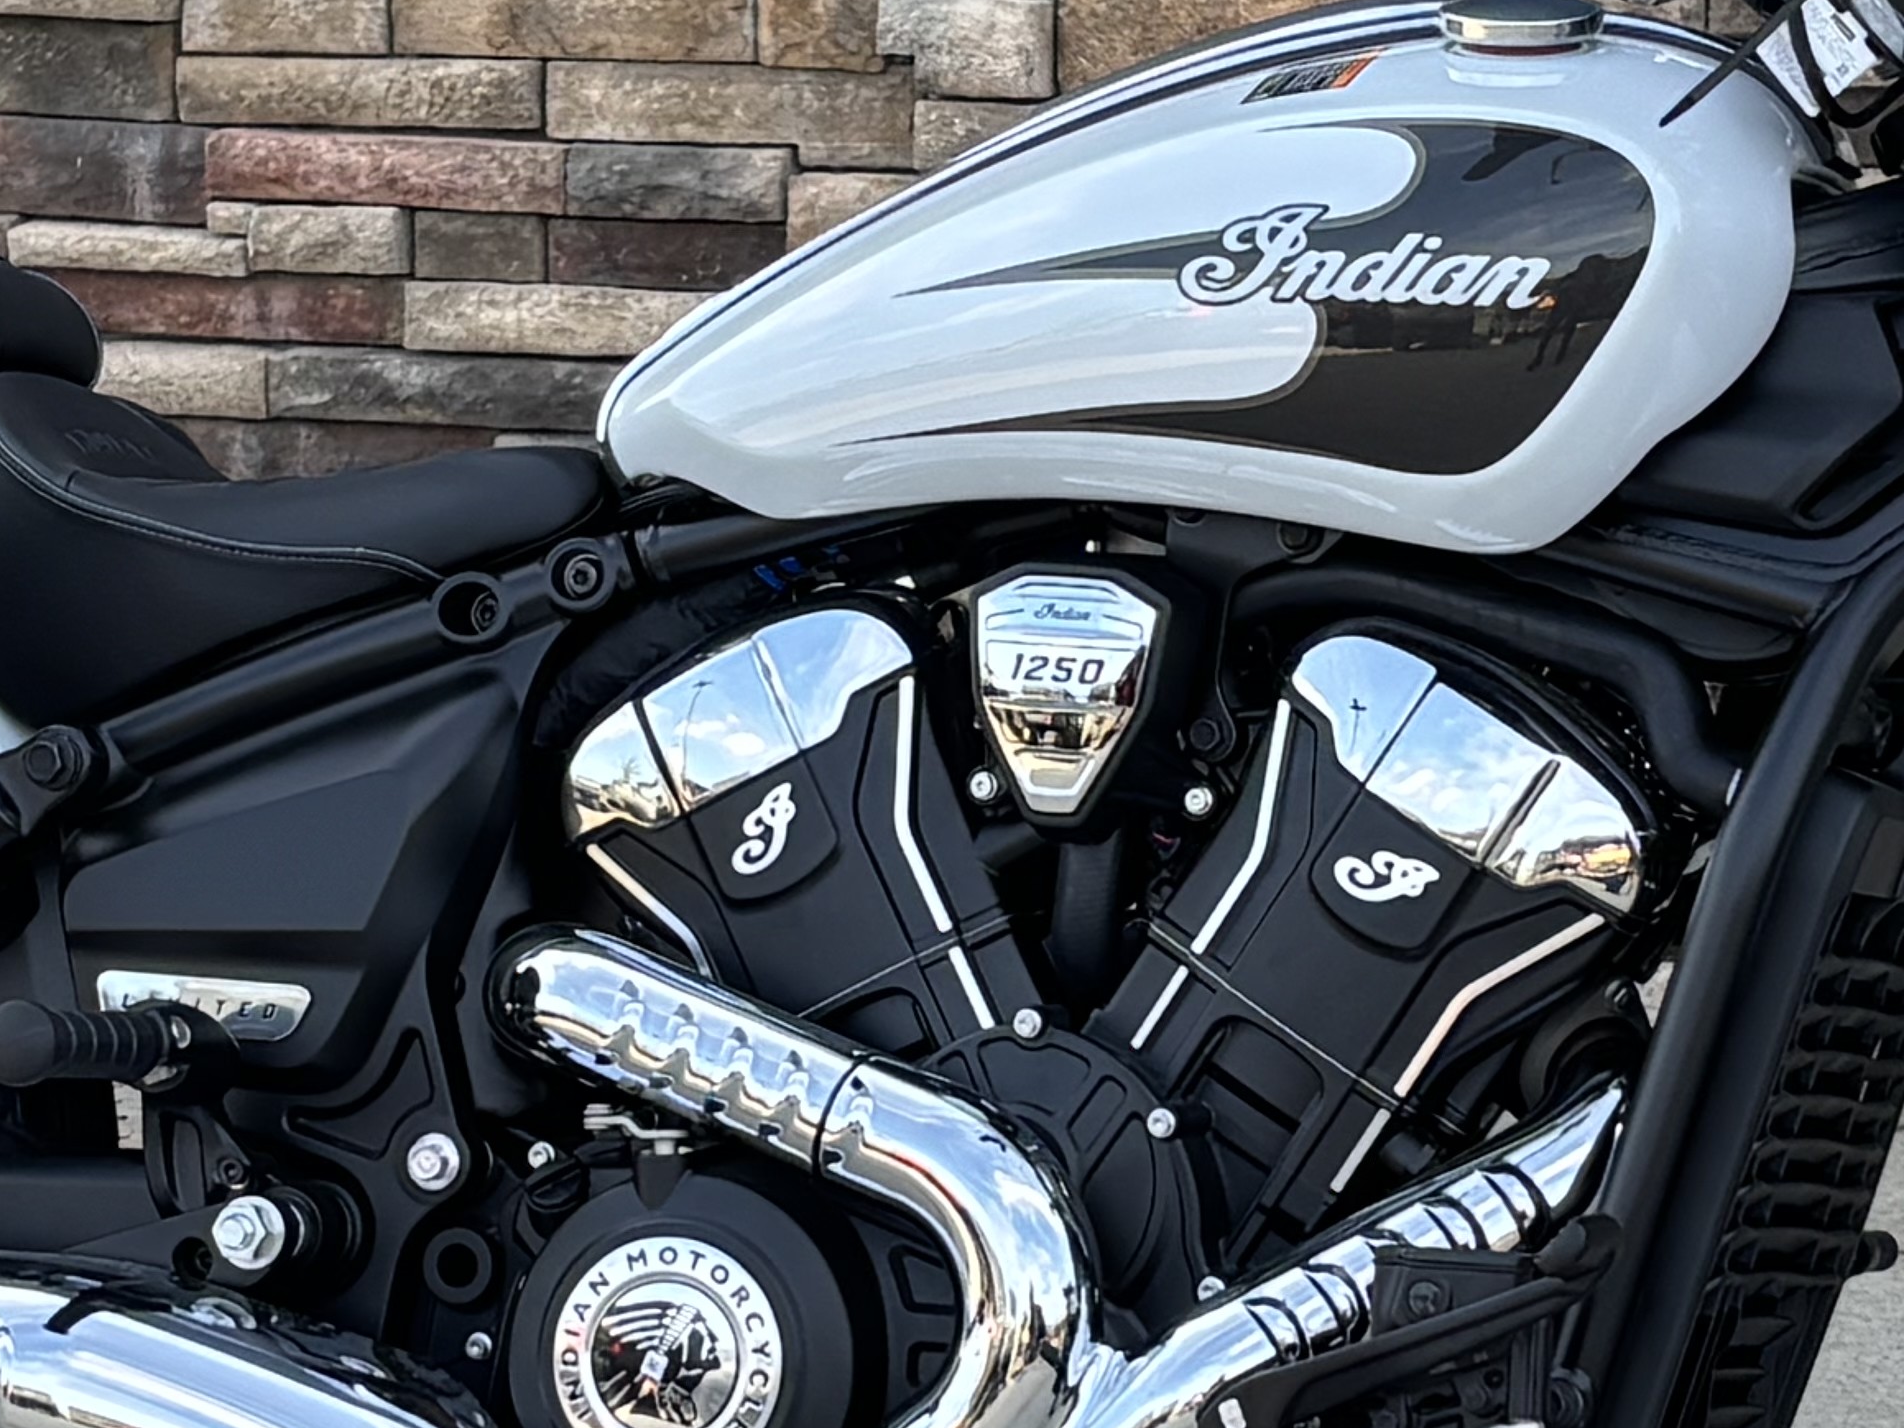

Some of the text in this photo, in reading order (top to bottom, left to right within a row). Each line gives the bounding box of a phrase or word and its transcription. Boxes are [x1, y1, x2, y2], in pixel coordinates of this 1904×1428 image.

[1178, 203, 1551, 309] Indian
[1033, 602, 1092, 621] Indian
[1011, 646, 1105, 685] 1250
[562, 1273, 610, 1420] INDIAN
